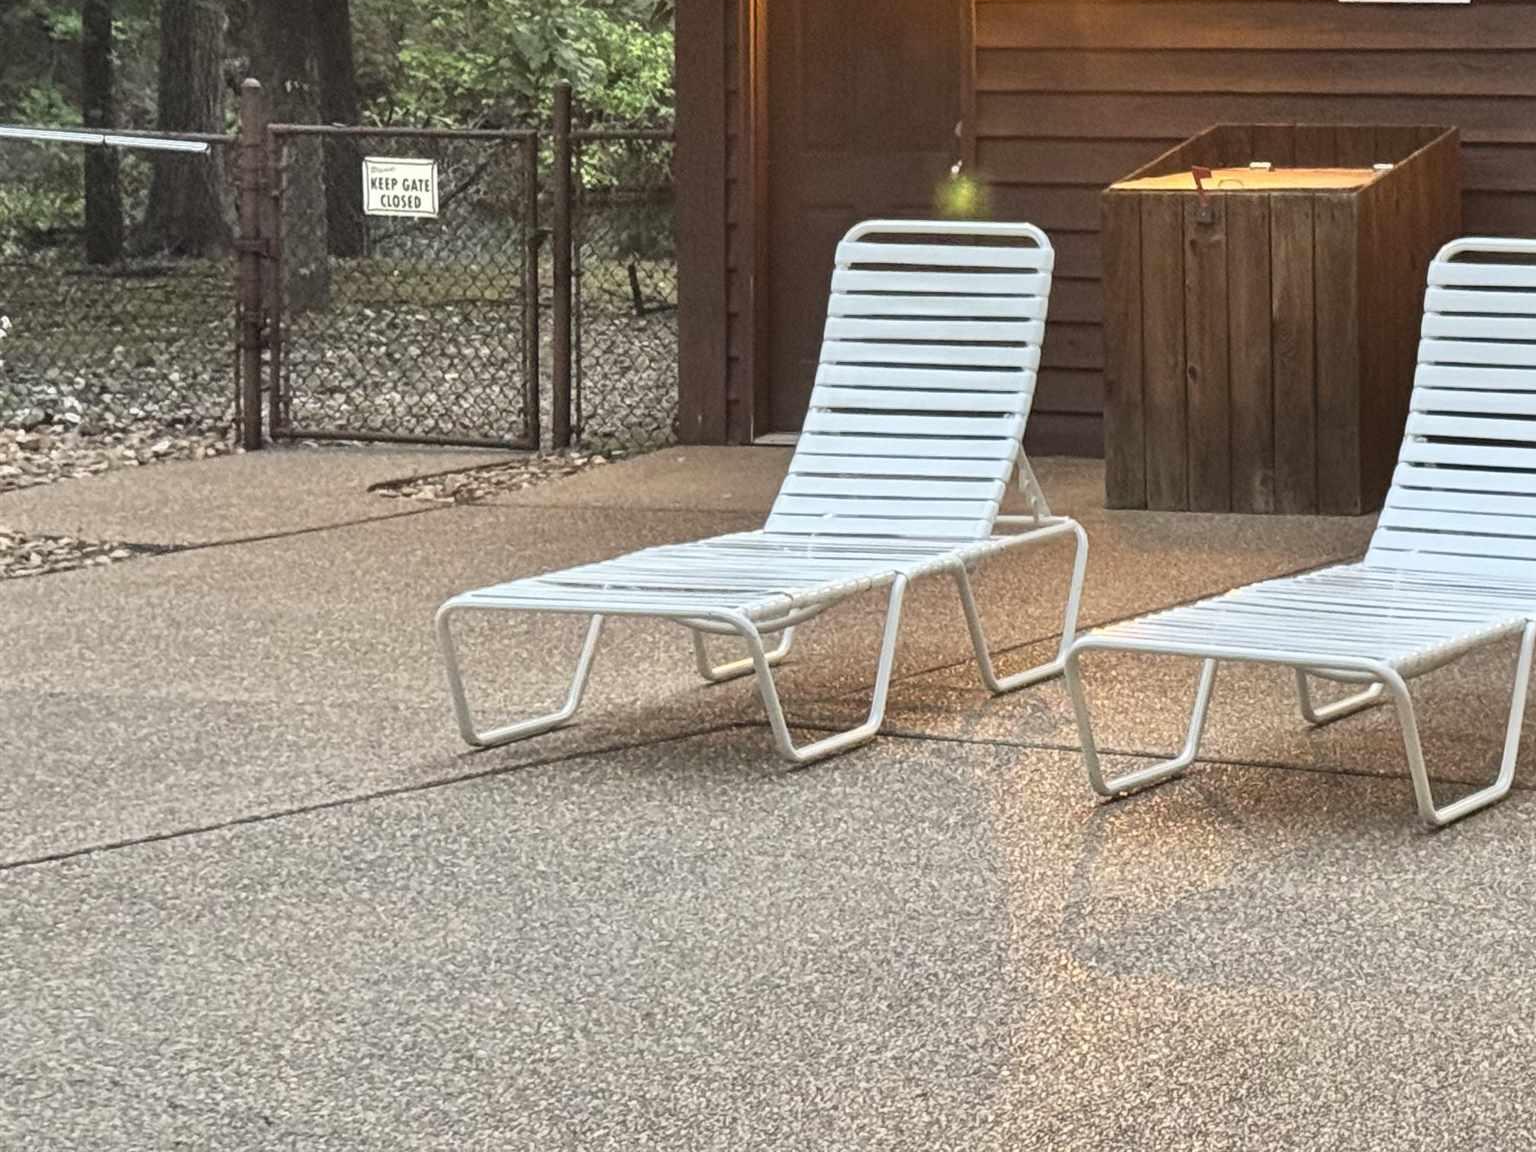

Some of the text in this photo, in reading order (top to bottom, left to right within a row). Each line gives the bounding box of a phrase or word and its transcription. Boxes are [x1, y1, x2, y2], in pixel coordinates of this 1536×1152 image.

[370, 176, 430, 193] KEEP GATE
[380, 194, 422, 209] CLOSED
